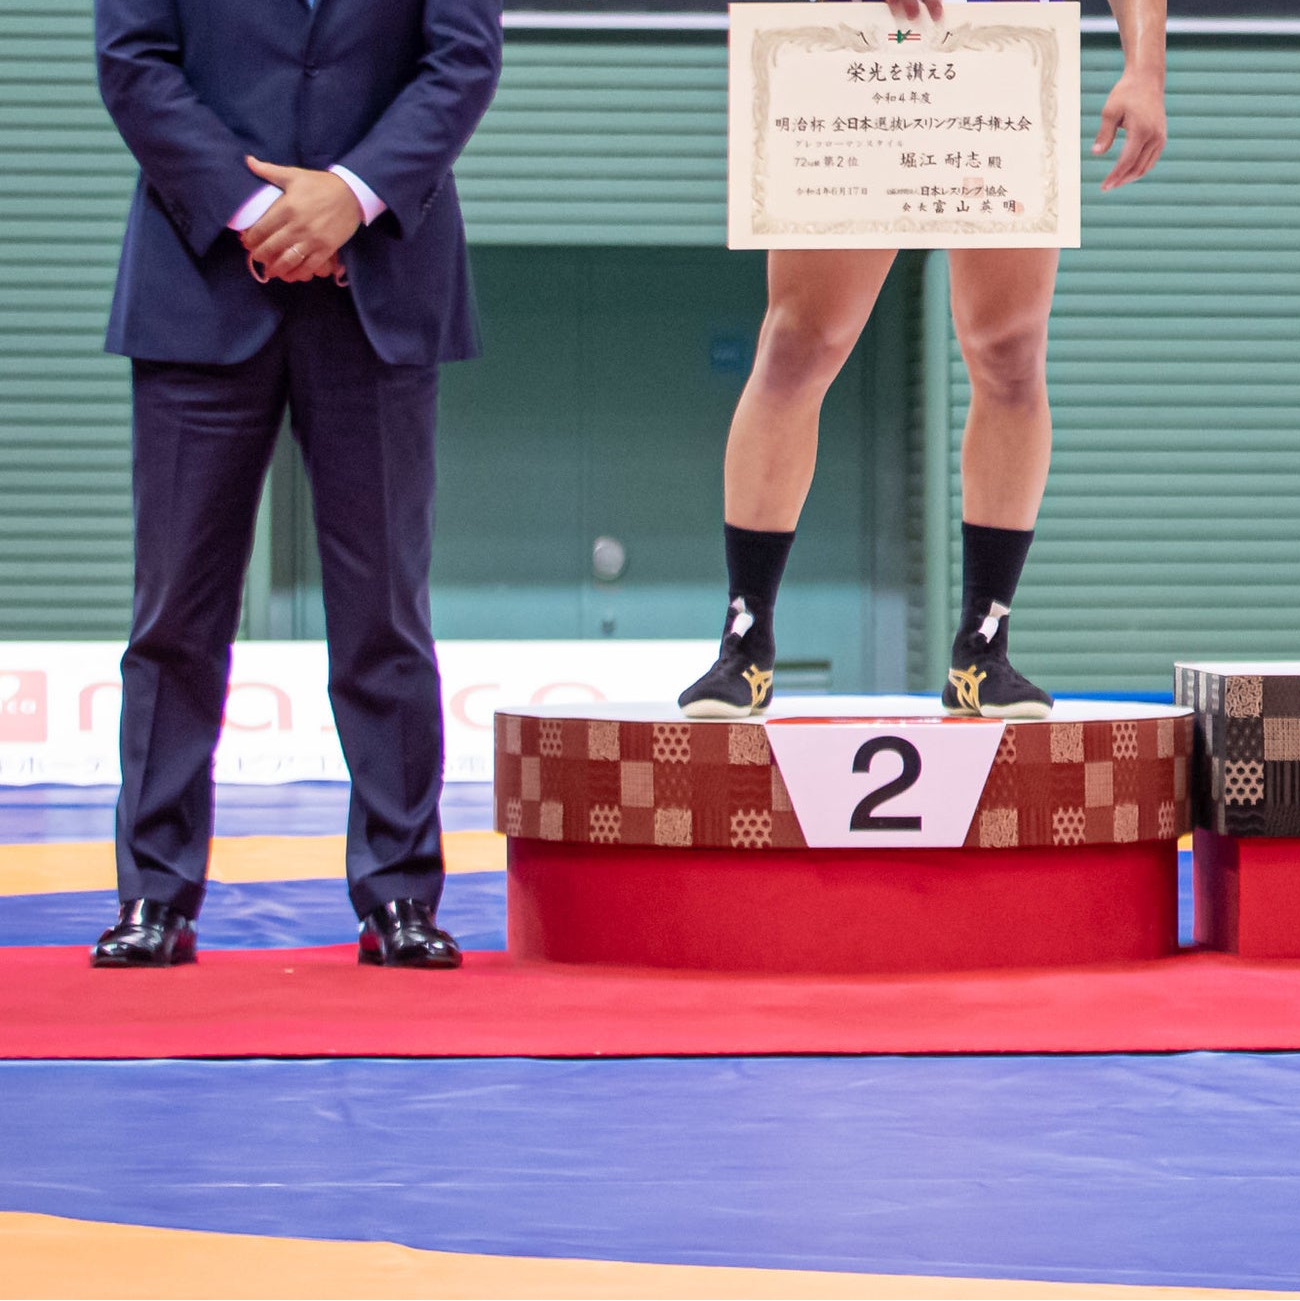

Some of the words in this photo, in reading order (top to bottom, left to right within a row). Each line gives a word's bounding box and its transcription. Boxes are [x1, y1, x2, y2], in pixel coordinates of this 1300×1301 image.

[846, 61, 957, 83] 栄光を讃える
[871, 90, 932, 105] 令和4年度
[775, 116, 826, 133] 明治杯
[832, 115, 1033, 133] 全日本選抜レスリング選手権大会
[900, 153, 937, 169] 堀江
[944, 151, 982, 169] 耐志
[849, 735, 922, 832] 2
